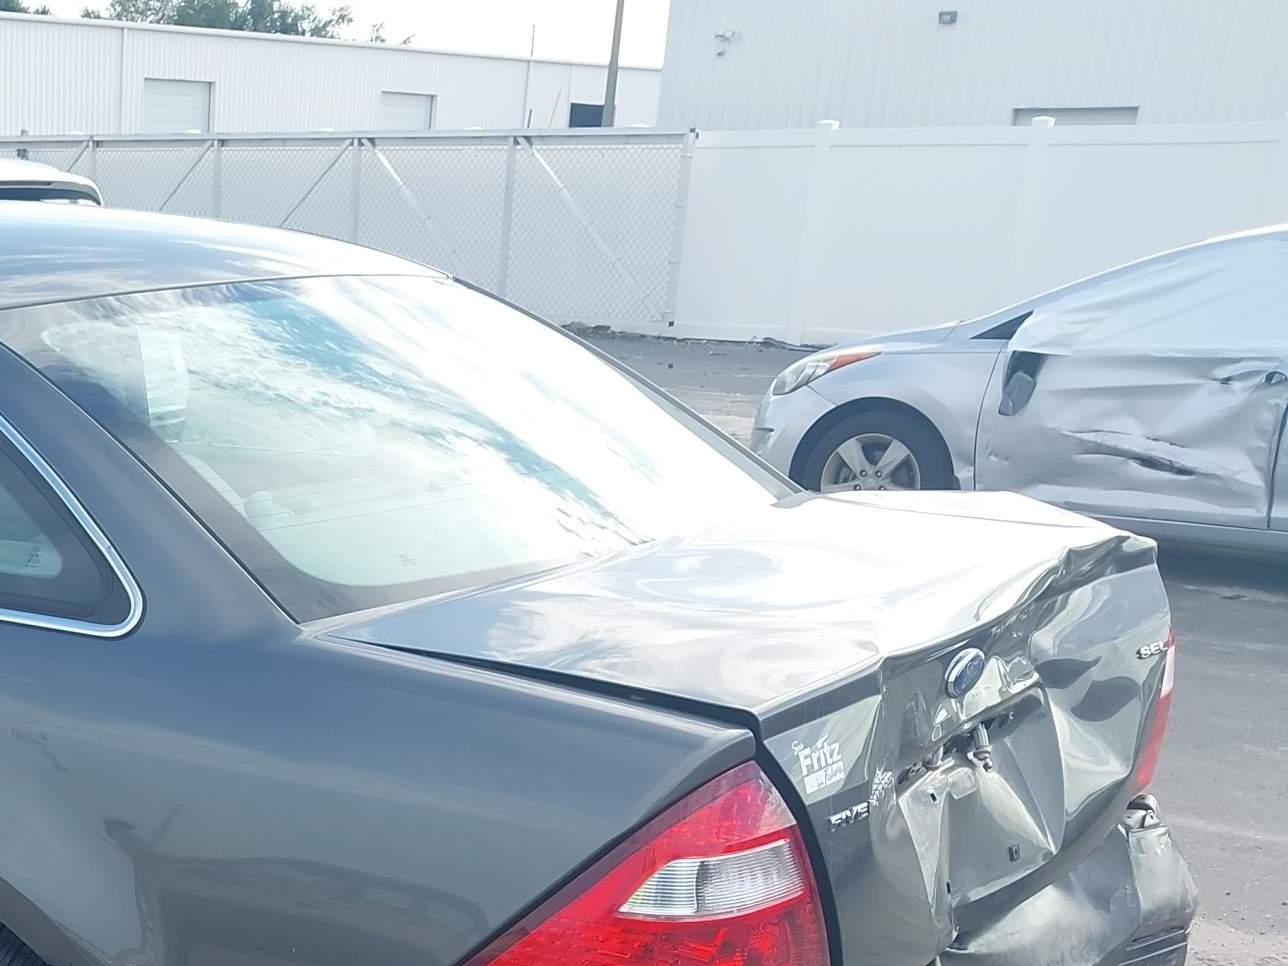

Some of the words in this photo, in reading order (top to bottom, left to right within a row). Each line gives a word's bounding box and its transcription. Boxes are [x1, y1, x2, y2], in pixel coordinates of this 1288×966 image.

[1140, 640, 1168, 658] SEL
[798, 742, 841, 776] Fritz
[829, 801, 870, 831] FIVE
